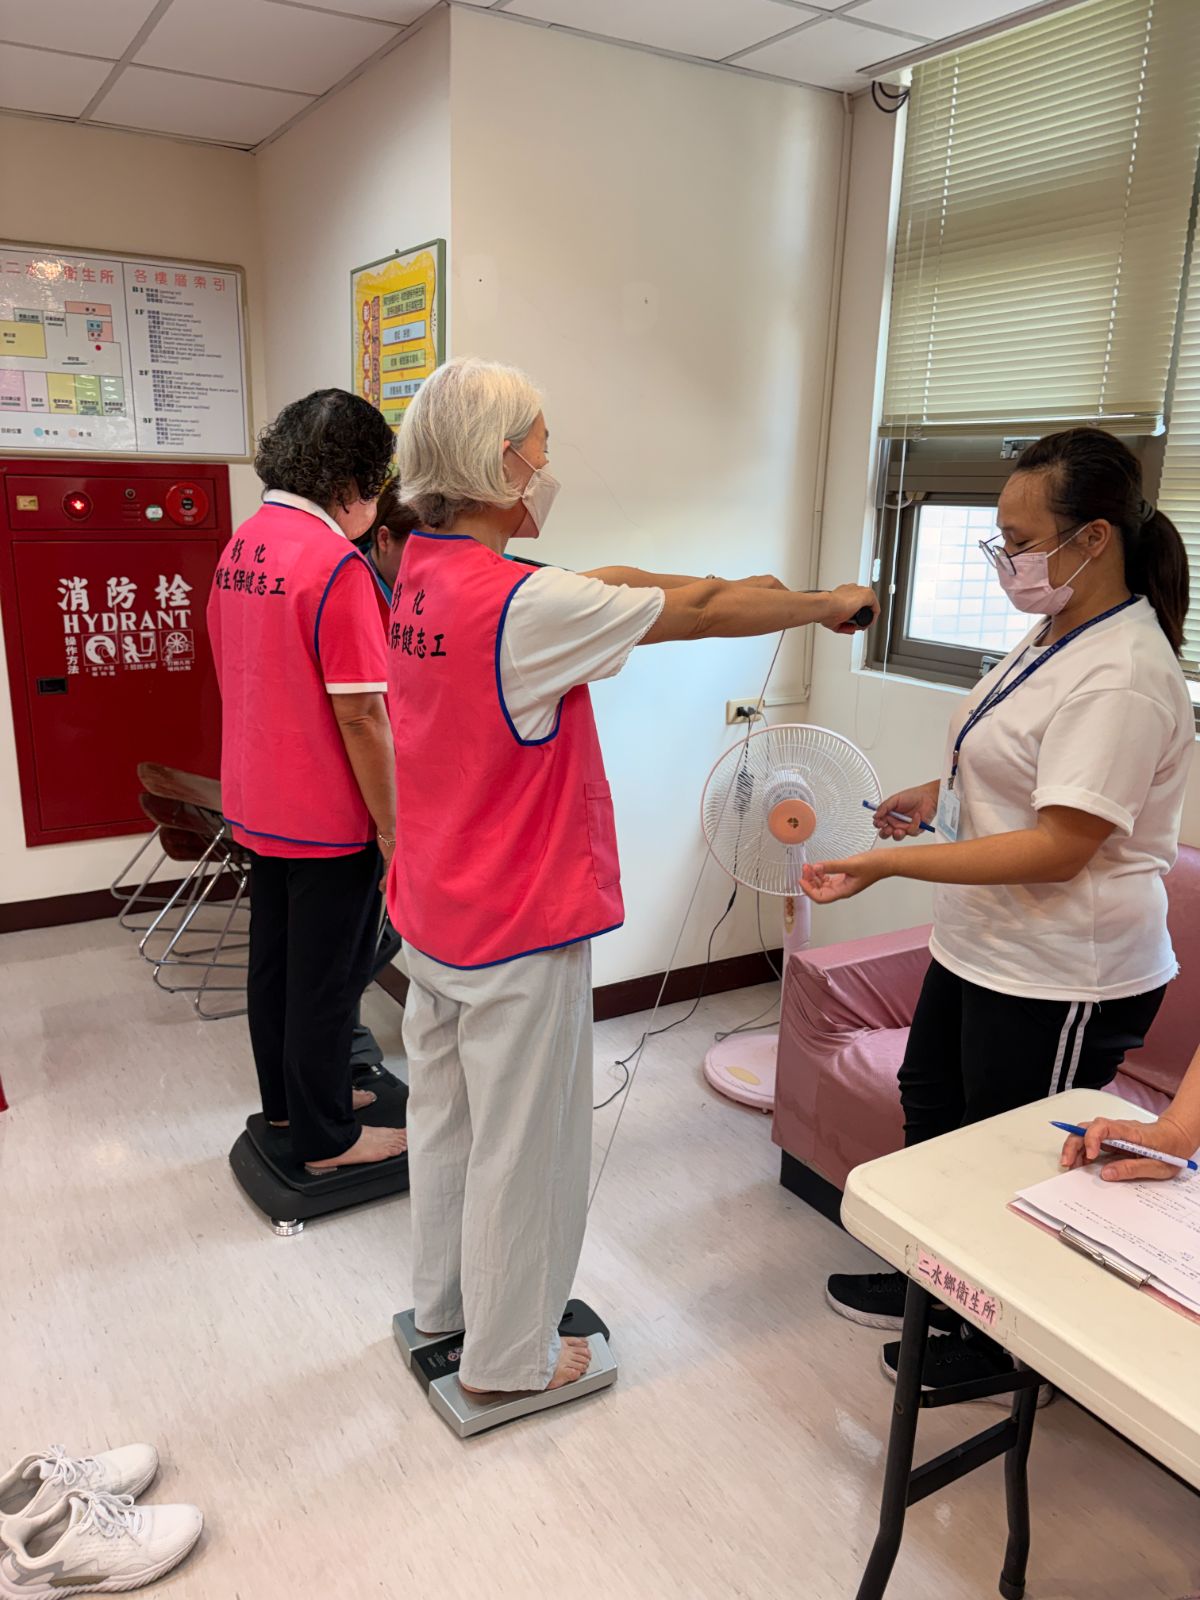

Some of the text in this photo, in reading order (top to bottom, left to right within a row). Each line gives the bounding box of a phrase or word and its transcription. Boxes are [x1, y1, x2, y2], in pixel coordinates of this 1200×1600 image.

[57, 574, 193, 612] 消防栓
[63, 610, 191, 634] HYDRANT
[918, 1259, 996, 1325] 二水鄉衛生所
